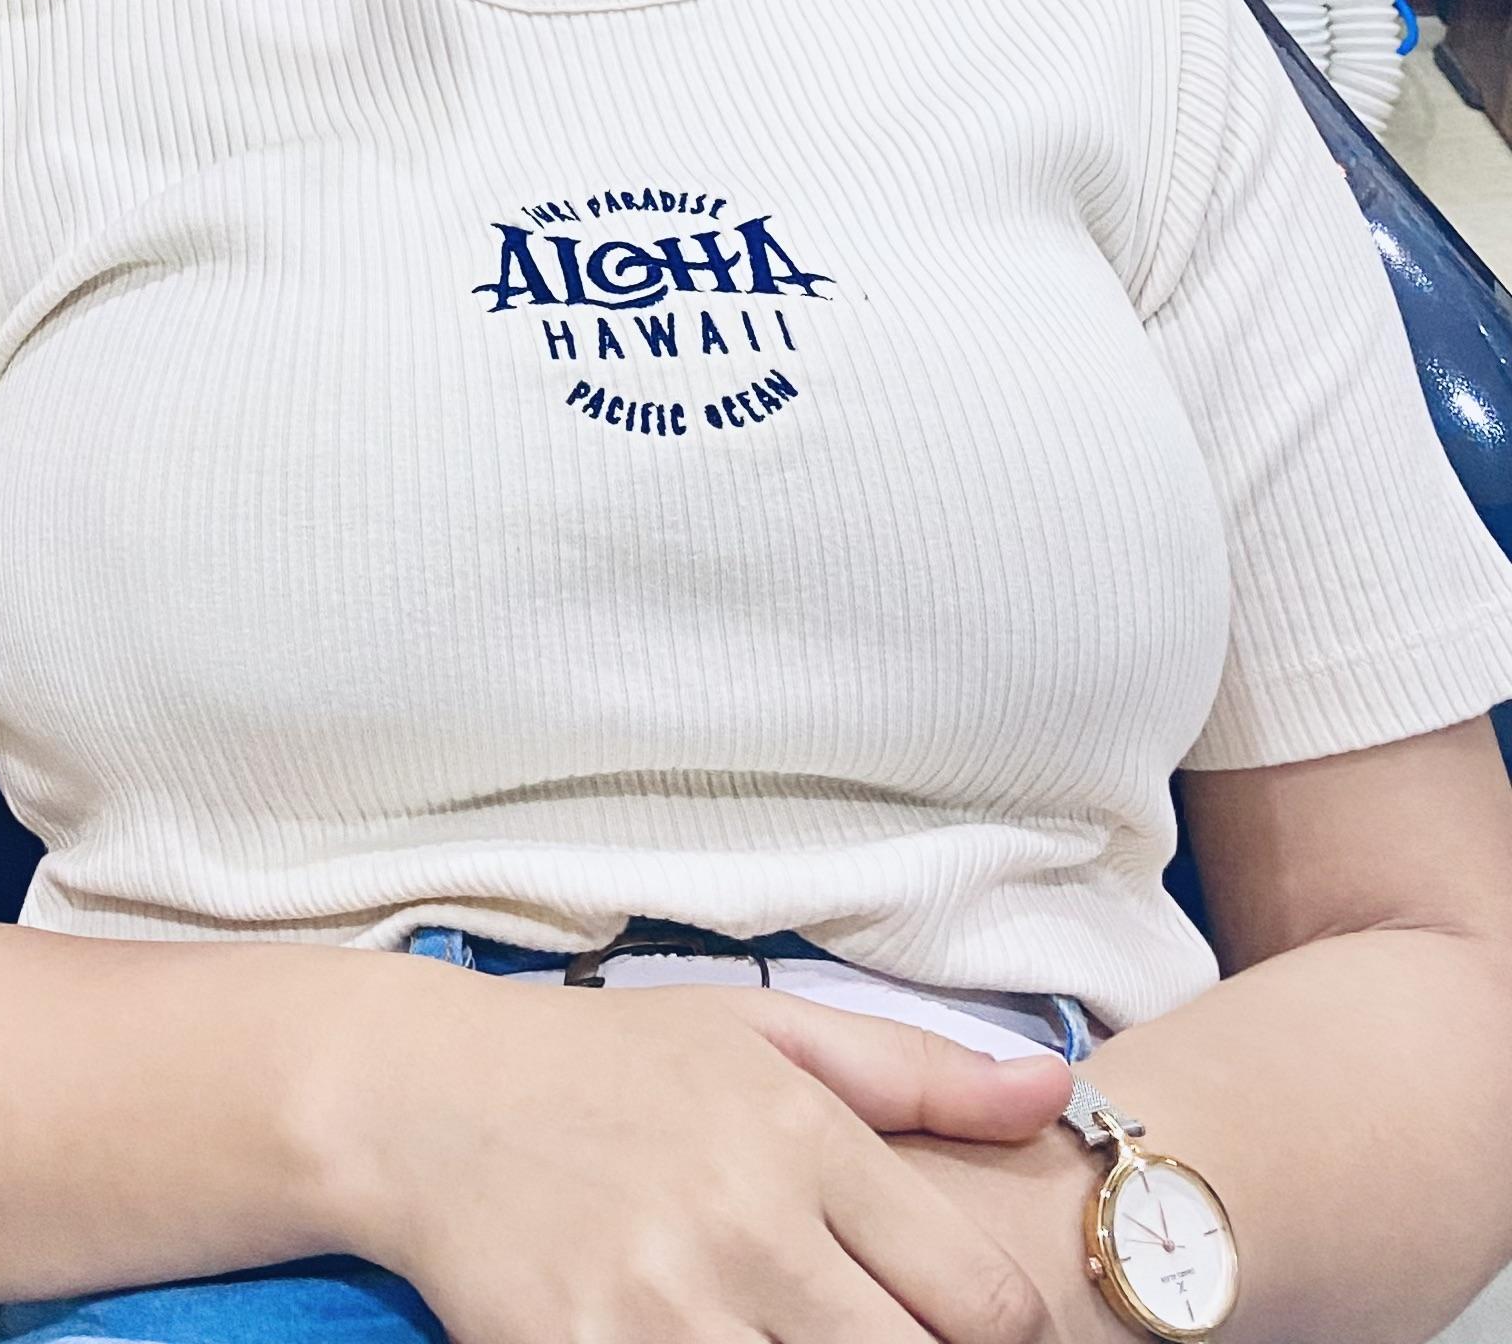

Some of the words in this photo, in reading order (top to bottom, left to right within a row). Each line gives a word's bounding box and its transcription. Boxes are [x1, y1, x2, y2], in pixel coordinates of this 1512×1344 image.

[586, 187, 727, 219] PARADISE
[471, 215, 837, 312] ALOHA
[542, 310, 797, 360] HAWAII
[565, 379, 687, 437] PACIFIC
[704, 369, 799, 429] OCEAN
